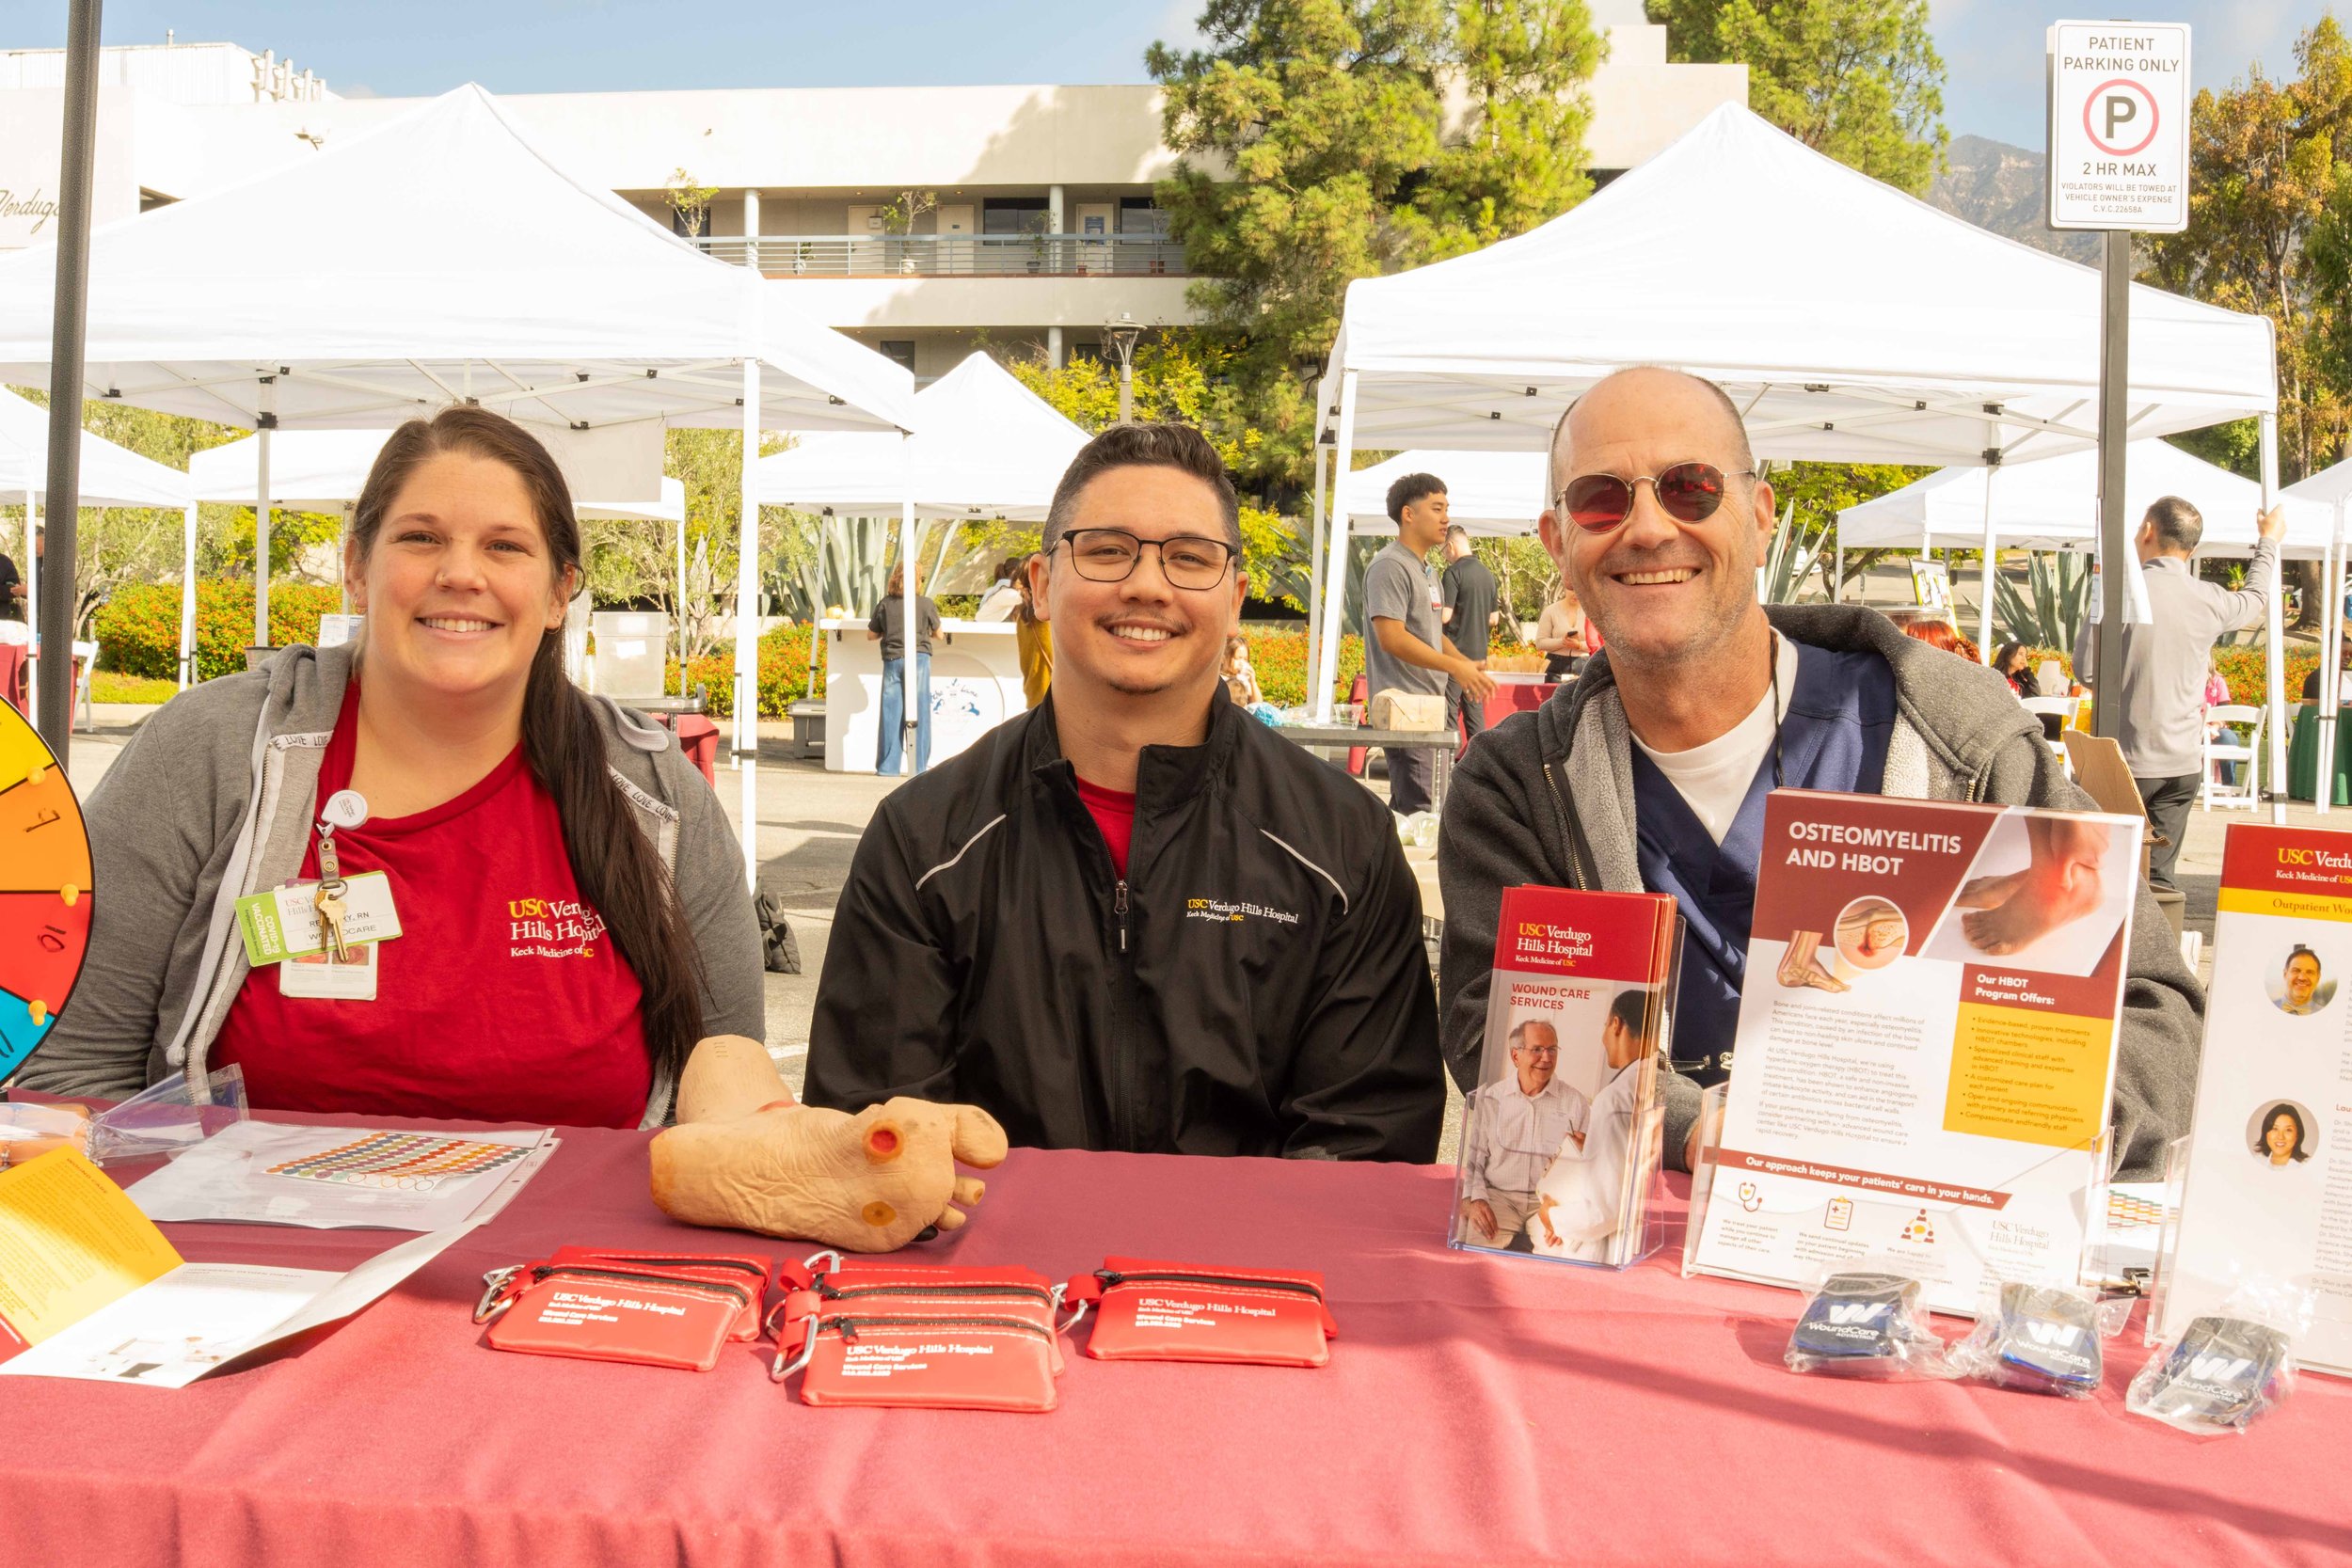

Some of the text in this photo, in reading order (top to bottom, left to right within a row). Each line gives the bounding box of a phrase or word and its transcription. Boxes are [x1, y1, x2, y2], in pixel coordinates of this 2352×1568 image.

[2090, 37, 2154, 51] PATIENT
[2064, 57, 2179, 71] PARKING ONLY
[2106, 96, 2137, 139] P
[2083, 162, 2156, 177] 2 HR MAX
[2062, 182, 2104, 191] VIOLATORS
[2106, 183, 2124, 192] WILL
[2139, 184, 2166, 193] TOWED
[2100, 194, 2136, 202] OWNER'S
[632, 792, 653, 809] LOVE
[1788, 820, 1963, 854] OSTEOMYELITIS
[1786, 848, 1904, 876] AND HBOT
[2278, 847, 2314, 865] USC
[2276, 869, 2295, 879] Keck
[2296, 871, 2329, 882] Medicine
[2339, 875, 2352, 884] US
[285, 897, 304, 907] USC
[508, 898, 548, 918] USC
[2273, 898, 2329, 912] Outpatient
[288, 907, 307, 916] Hills
[1188, 899, 1298, 924] USC Verdugo Hills Hospital
[251, 903, 272, 956] VACCINATED
[265, 915, 280, 954] COVID-19
[510, 920, 553, 941] Hills
[1518, 923, 1591, 944] USC Verdugo
[511, 946, 534, 958] Keck
[536, 945, 573, 958] Medicine
[574, 944, 583, 955] of
[1517, 938, 1593, 958] Hills Hospital
[1516, 955, 1530, 963] Keck
[1530, 956, 1555, 965] Medicine
[1977, 974, 2028, 989] Our HBOT
[1512, 983, 1591, 1000] WOUND CARE
[1976, 987, 2055, 1005] Program Offers:
[1510, 995, 1565, 1010] SERVICES
[1977, 1028, 2010, 1037] Innovative
[2057, 1038, 2086, 1048] including
[1746, 1156, 1994, 1204] Our approach keeps your patients' care in your hands.
[1993, 1220, 2049, 1238] USC Verdugo
[1990, 1231, 2011, 1243] Hills
[2013, 1234, 2049, 1251] Hospital
[1138, 1298, 1164, 1307] USC
[1165, 1299, 1205, 1311] Verdugo
[1207, 1303, 1232, 1313] Hills
[1234, 1306, 1277, 1317] Hospital
[1809, 1322, 1880, 1336] WoundCare
[2015, 1338, 2090, 1364] WoundCare
